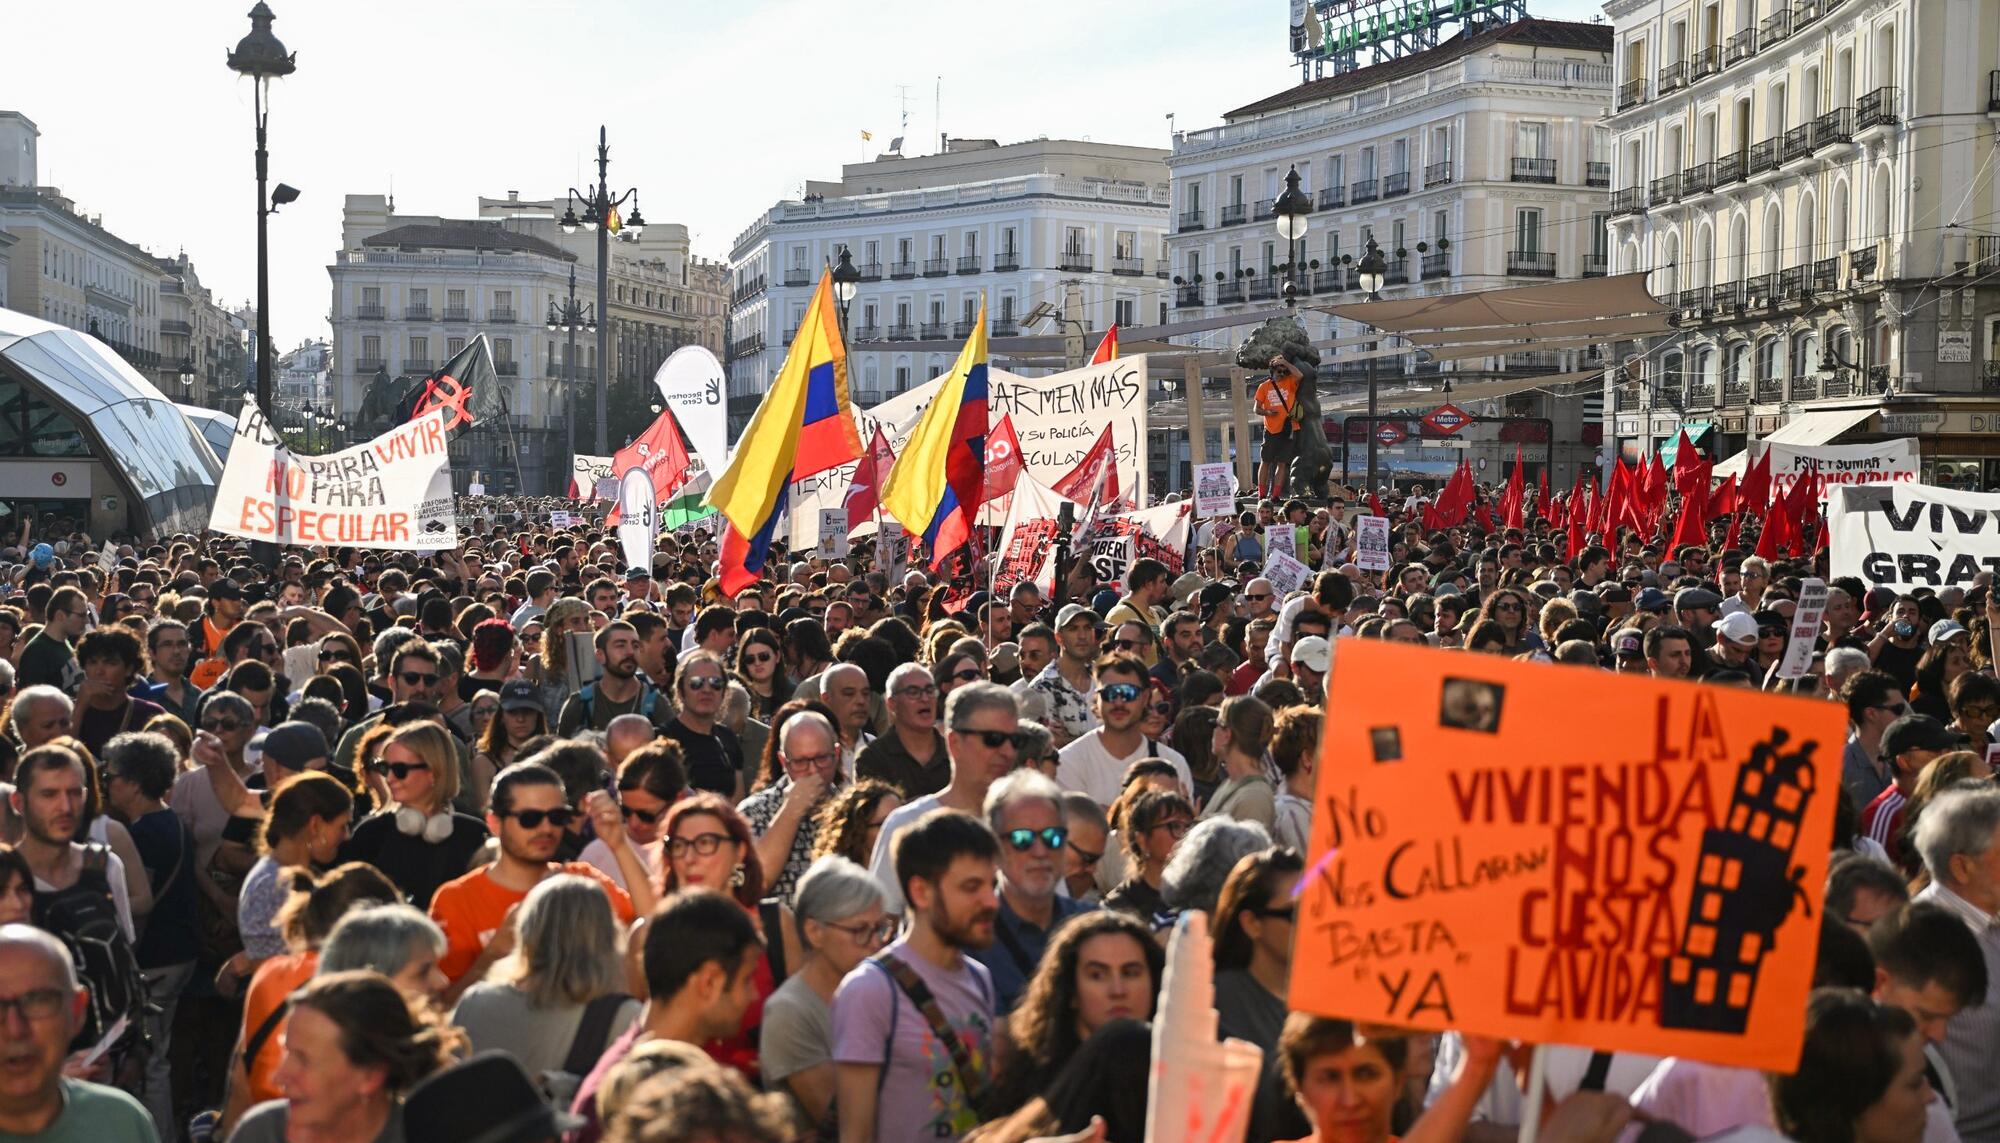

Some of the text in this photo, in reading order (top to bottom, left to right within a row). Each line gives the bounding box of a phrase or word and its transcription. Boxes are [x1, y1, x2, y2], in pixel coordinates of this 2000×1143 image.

[1091, 365, 1139, 409] MÁS
[1028, 431, 1046, 440] SU
[1050, 420, 1094, 439] POLICÍA
[1436, 415, 1459, 424] Metro
[375, 418, 445, 465] VIVIR
[1380, 432, 1396, 440] Metro
[1440, 440, 1453, 448] Sol
[310, 450, 379, 481] PARA
[1506, 453, 1546, 461] SEHORA
[1836, 456, 1880, 470] SUMAR
[265, 459, 386, 507] NO PARA
[239, 496, 410, 543] ESPECULAR
[1879, 500, 2000, 534] VIV
[417, 535, 455, 545] ALCORCÓN
[1095, 557, 1127, 582] SE
[1655, 692, 1727, 761] LA
[1448, 762, 1718, 829] VIVIENDA
[1553, 825, 1680, 894] NOS
[1520, 888, 1680, 956] CUESTA
